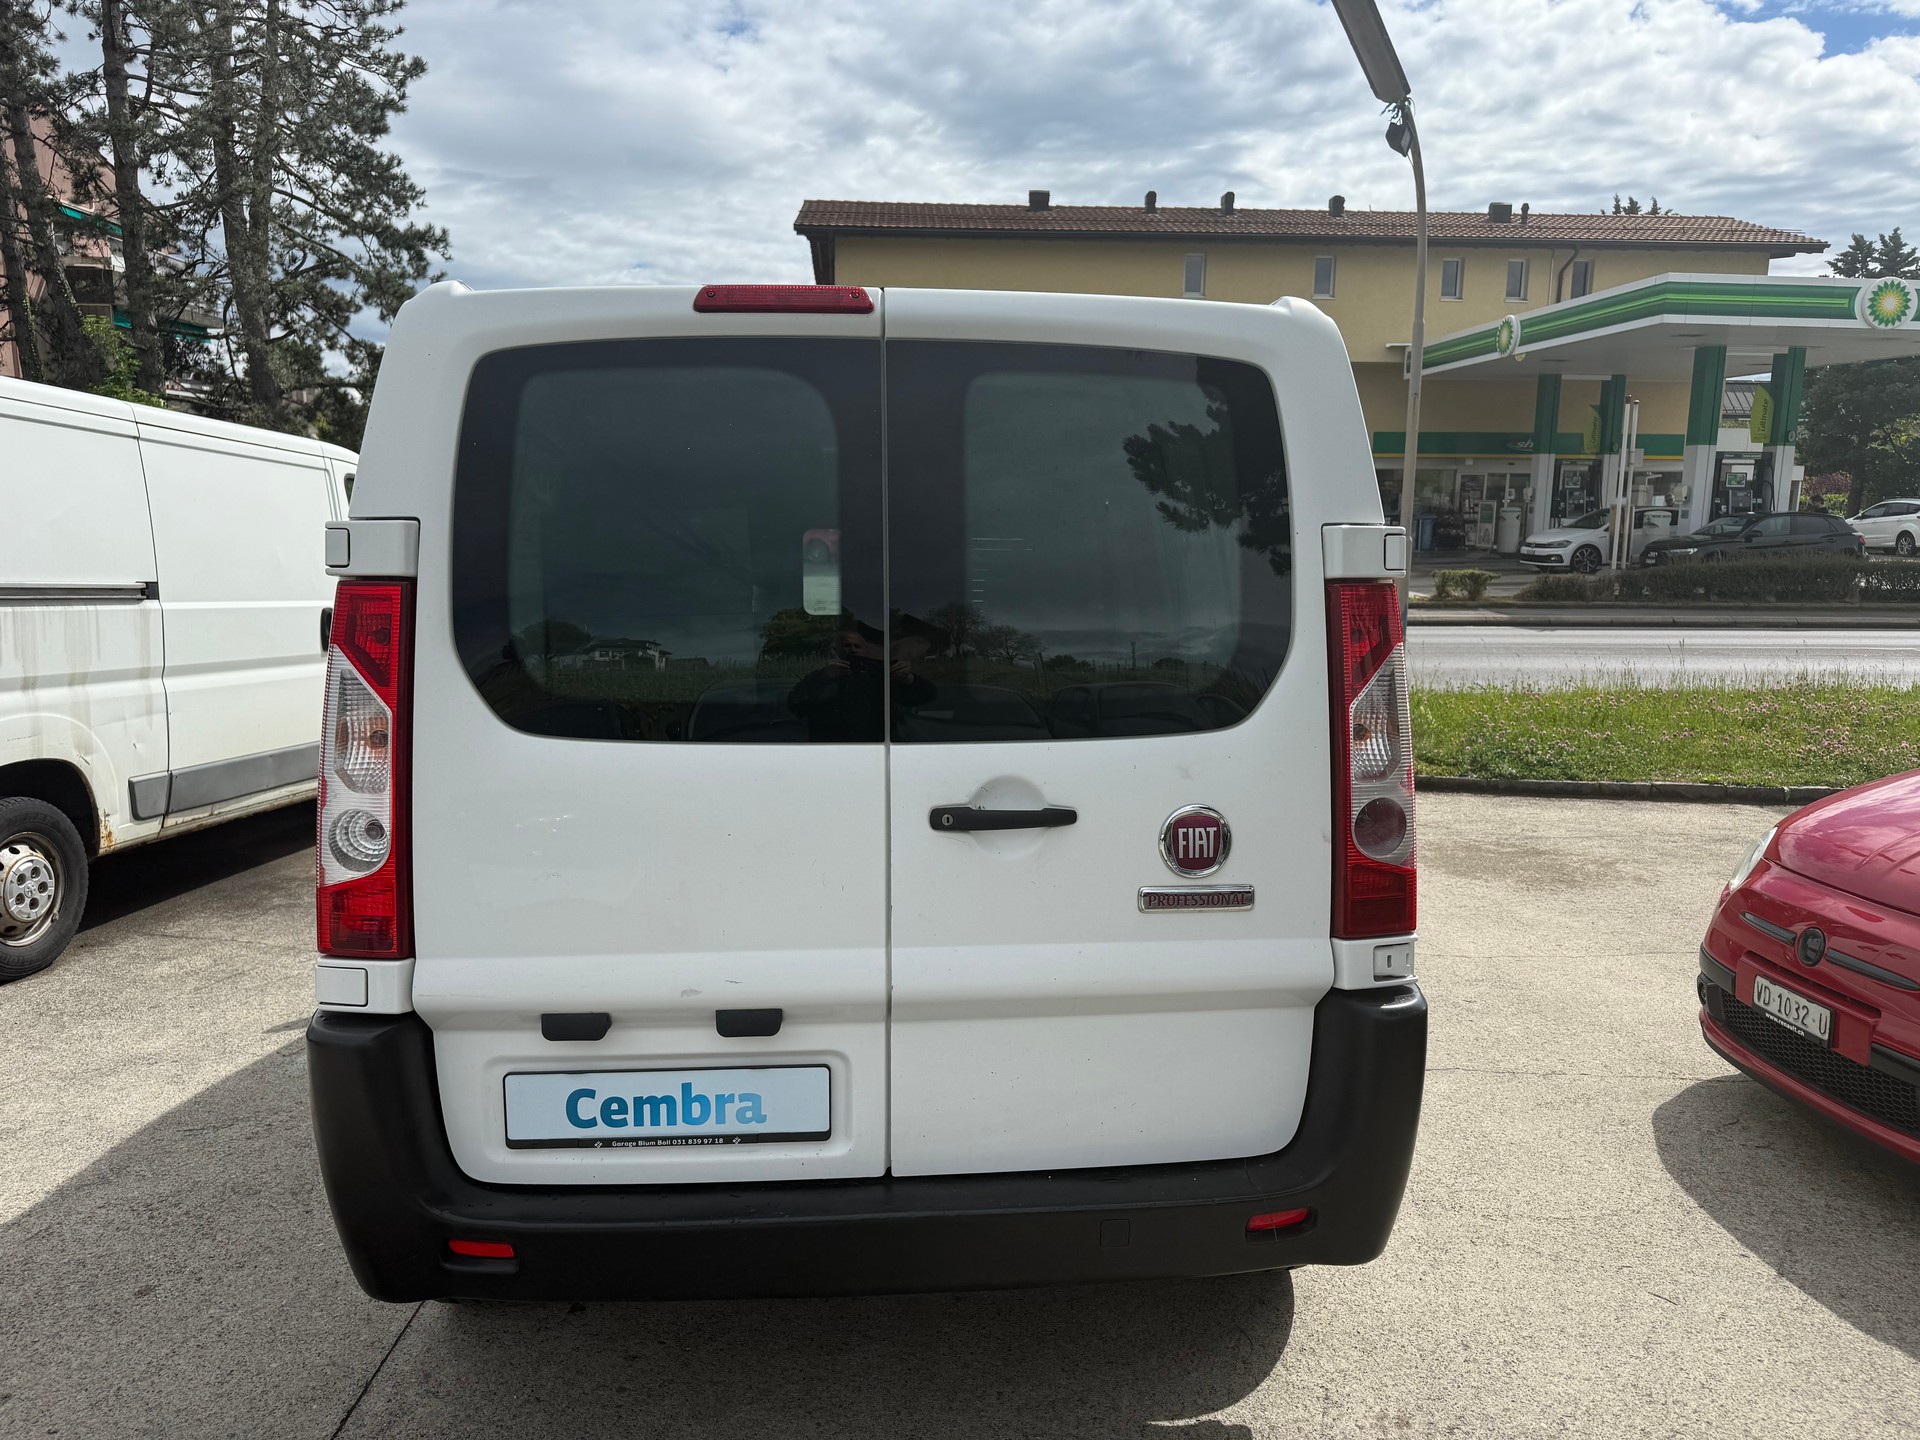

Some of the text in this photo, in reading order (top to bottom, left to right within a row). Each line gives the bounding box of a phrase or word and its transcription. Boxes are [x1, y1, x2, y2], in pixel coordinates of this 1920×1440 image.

[1177, 826, 1218, 859] FIAT
[1147, 893, 1248, 907] PROFESSIONAL
[1765, 1012, 1805, 1037] www.renault.ch
[565, 1081, 768, 1129] Cembra
[611, 1140, 637, 1148] Garage
